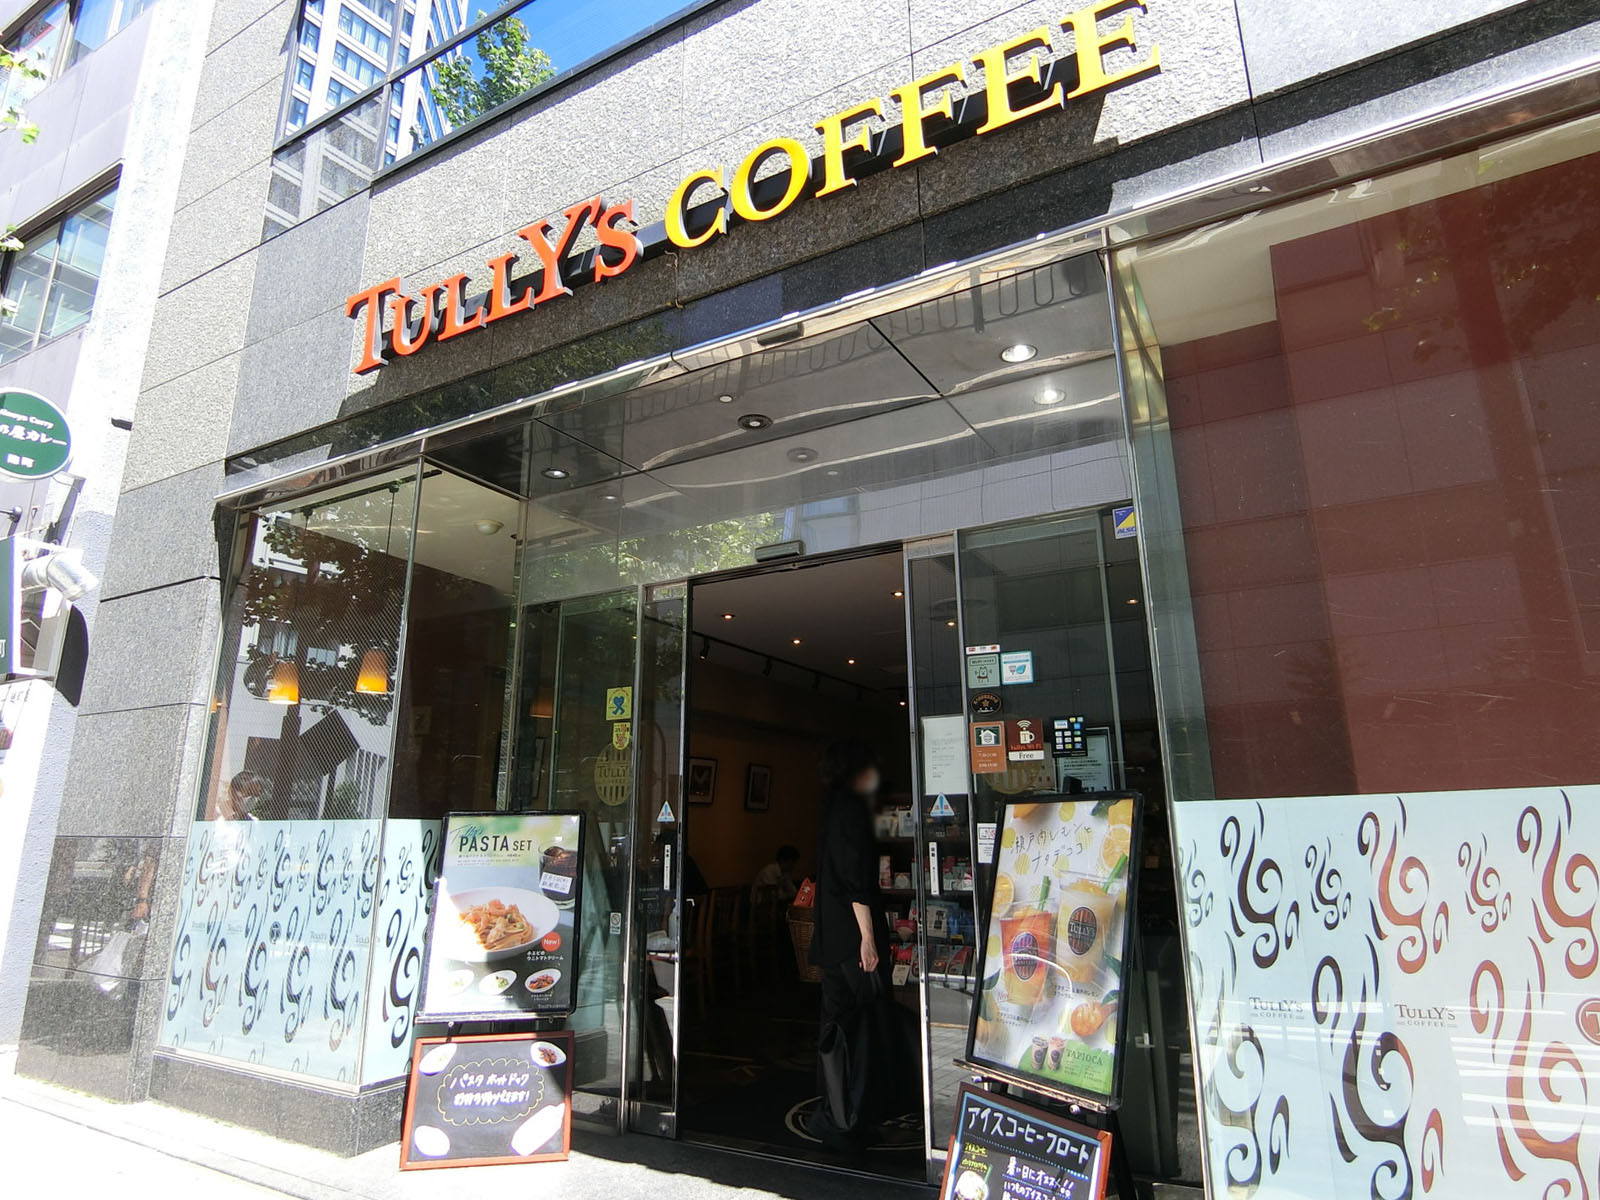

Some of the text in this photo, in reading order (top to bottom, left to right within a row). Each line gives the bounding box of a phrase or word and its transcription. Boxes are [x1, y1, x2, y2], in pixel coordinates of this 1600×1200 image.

[664, 0, 1161, 248] COFFEE
[1019, 752, 1034, 760] Free
[459, 835, 533, 852] PASTA SET
[543, 938, 561, 946] New!
[1393, 1003, 1456, 1021] TULLY'S
[1407, 1019, 1446, 1028] COFFEE
[1066, 1049, 1104, 1066] TAPIOCA
[450, 1073, 484, 1089] パスタ
[967, 1106, 1090, 1165] アイスコーヒーフロート
